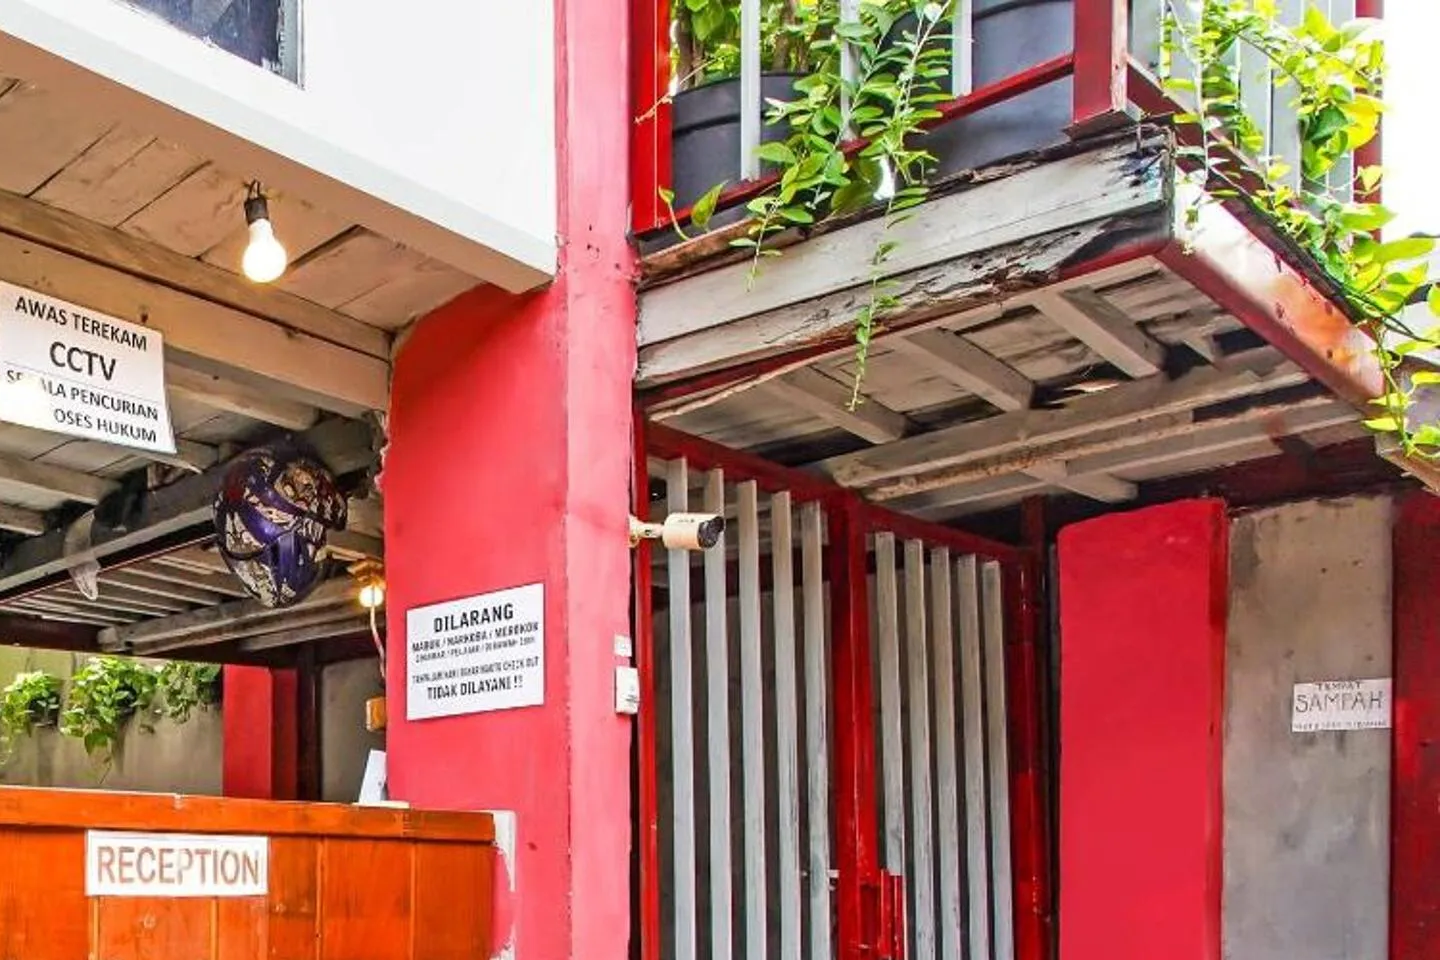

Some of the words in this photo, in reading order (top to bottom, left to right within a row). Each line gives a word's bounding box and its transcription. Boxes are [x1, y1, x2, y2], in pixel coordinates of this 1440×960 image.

[15, 296, 67, 326] AWAS
[73, 313, 147, 351] TEREKAM
[50, 342, 116, 381] CCTV
[71, 387, 159, 421] PENCURIAN
[97, 418, 157, 443] HUKUM
[434, 604, 513, 632] DILARANG
[427, 684, 457, 700] TIDAK
[460, 675, 511, 696] DILAYANI
[1295, 690, 1382, 713] SAMPAH
[97, 846, 259, 885] RECEPTION
